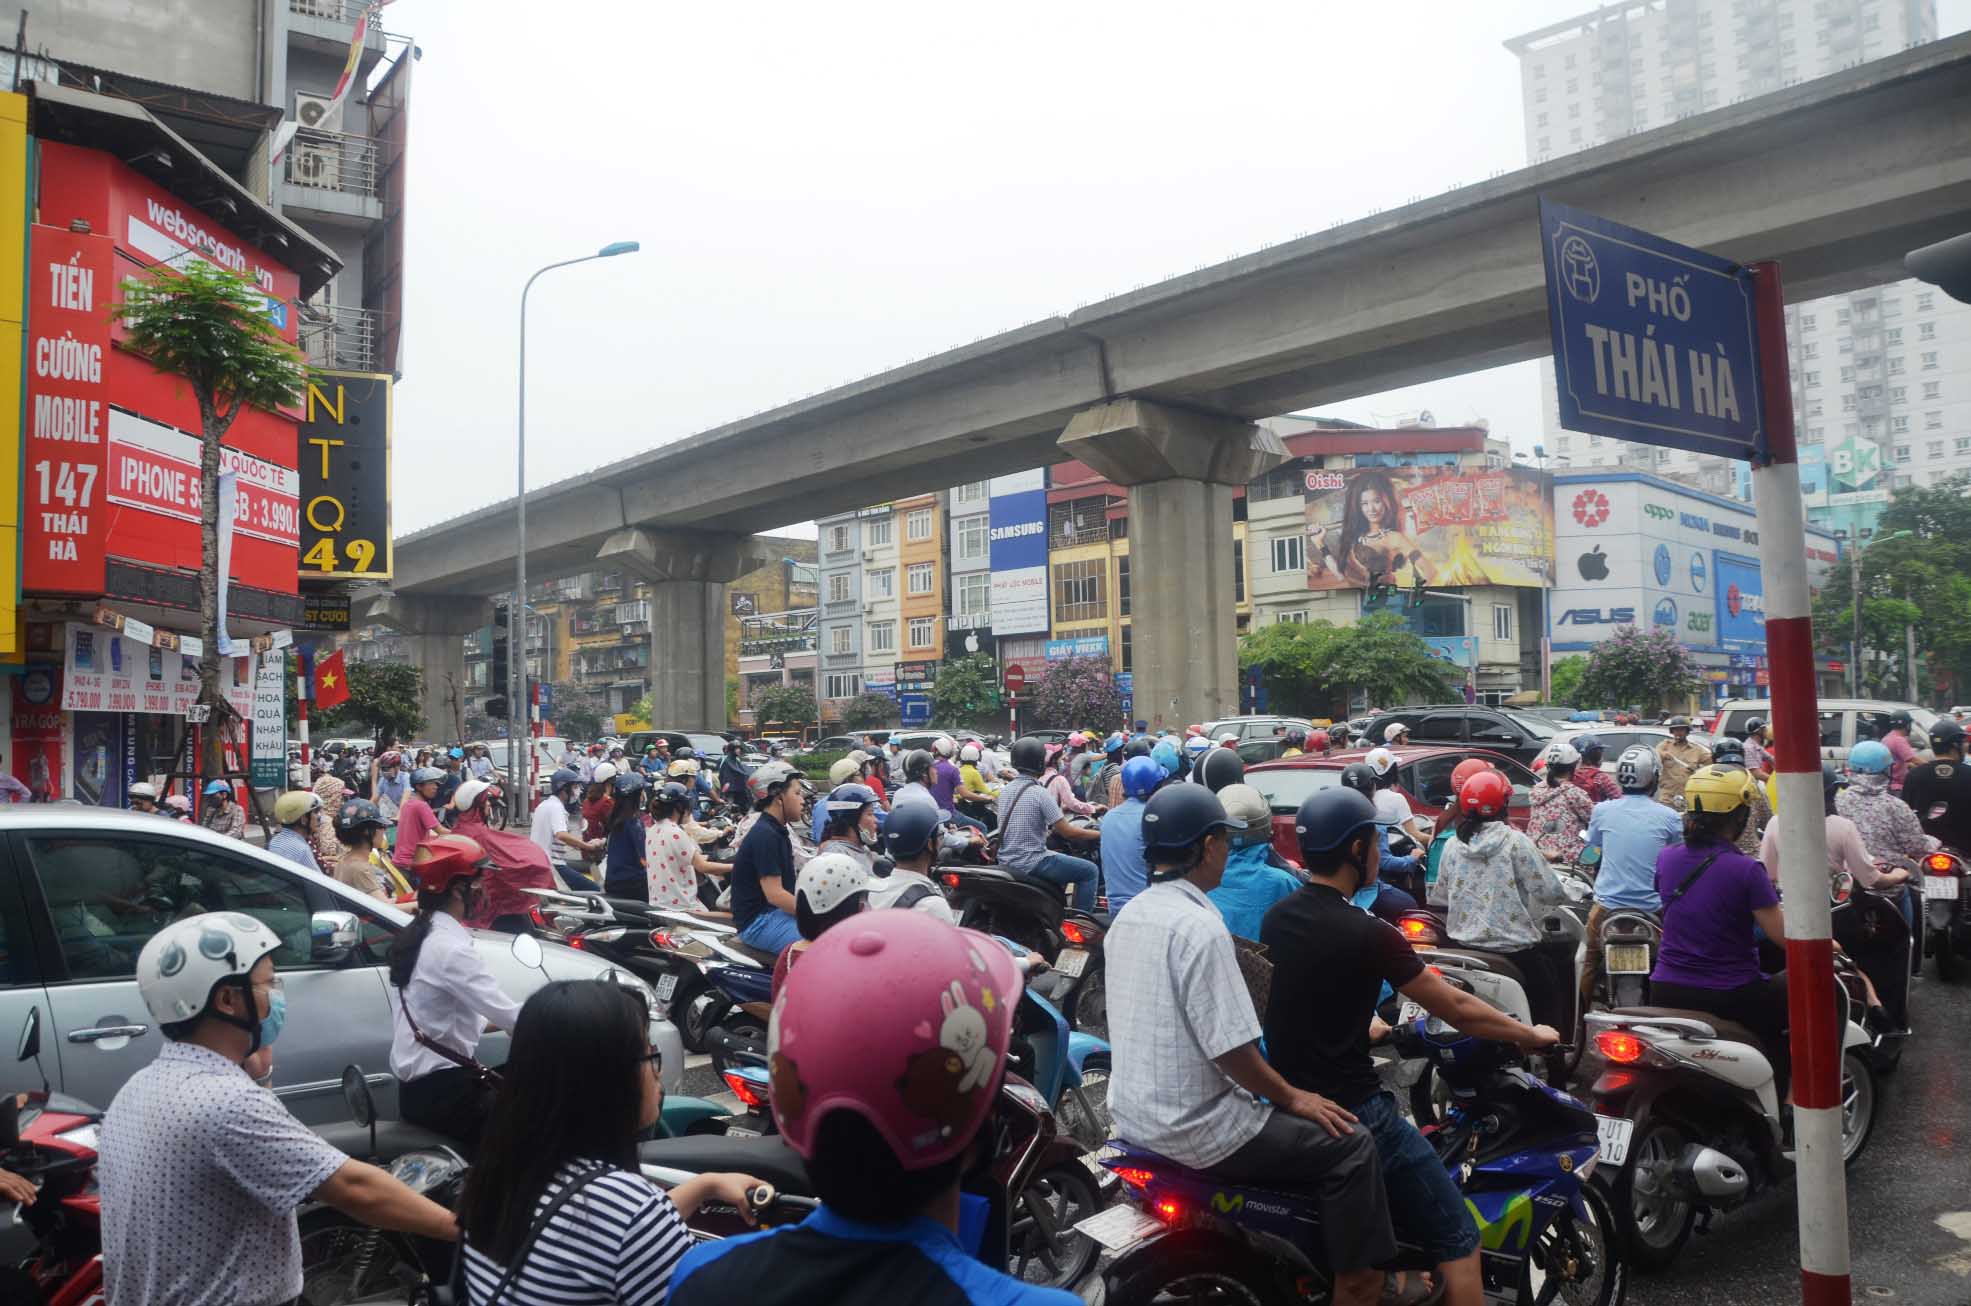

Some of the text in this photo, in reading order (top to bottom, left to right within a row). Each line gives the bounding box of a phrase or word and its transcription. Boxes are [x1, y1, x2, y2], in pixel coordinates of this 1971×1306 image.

[50, 251, 93, 312] TIẾN
[1626, 272, 1691, 322] PHỐ
[36, 330, 101, 384] CƯỜNG
[1585, 323, 1740, 422] THÁI HÀ
[34, 394, 100, 444] MOBILE
[35, 460, 98, 507] 147
[121, 456, 186, 505] IPHONE
[1305, 472, 1345, 489] Oishi
[41, 510, 88, 534] THÁI
[990, 521, 1044, 541] SAMSUNG
[49, 537, 78, 561] HÀ
[303, 537, 375, 573] 49
[1557, 607, 1635, 625] ASUS
[1687, 611, 1713, 632] acer
[257, 693, 281, 704] HOA
[1601, 1120, 1622, 1141] -U1
[1600, 1142, 1623, 1161] .10
[1246, 1200, 1291, 1216] movistar
